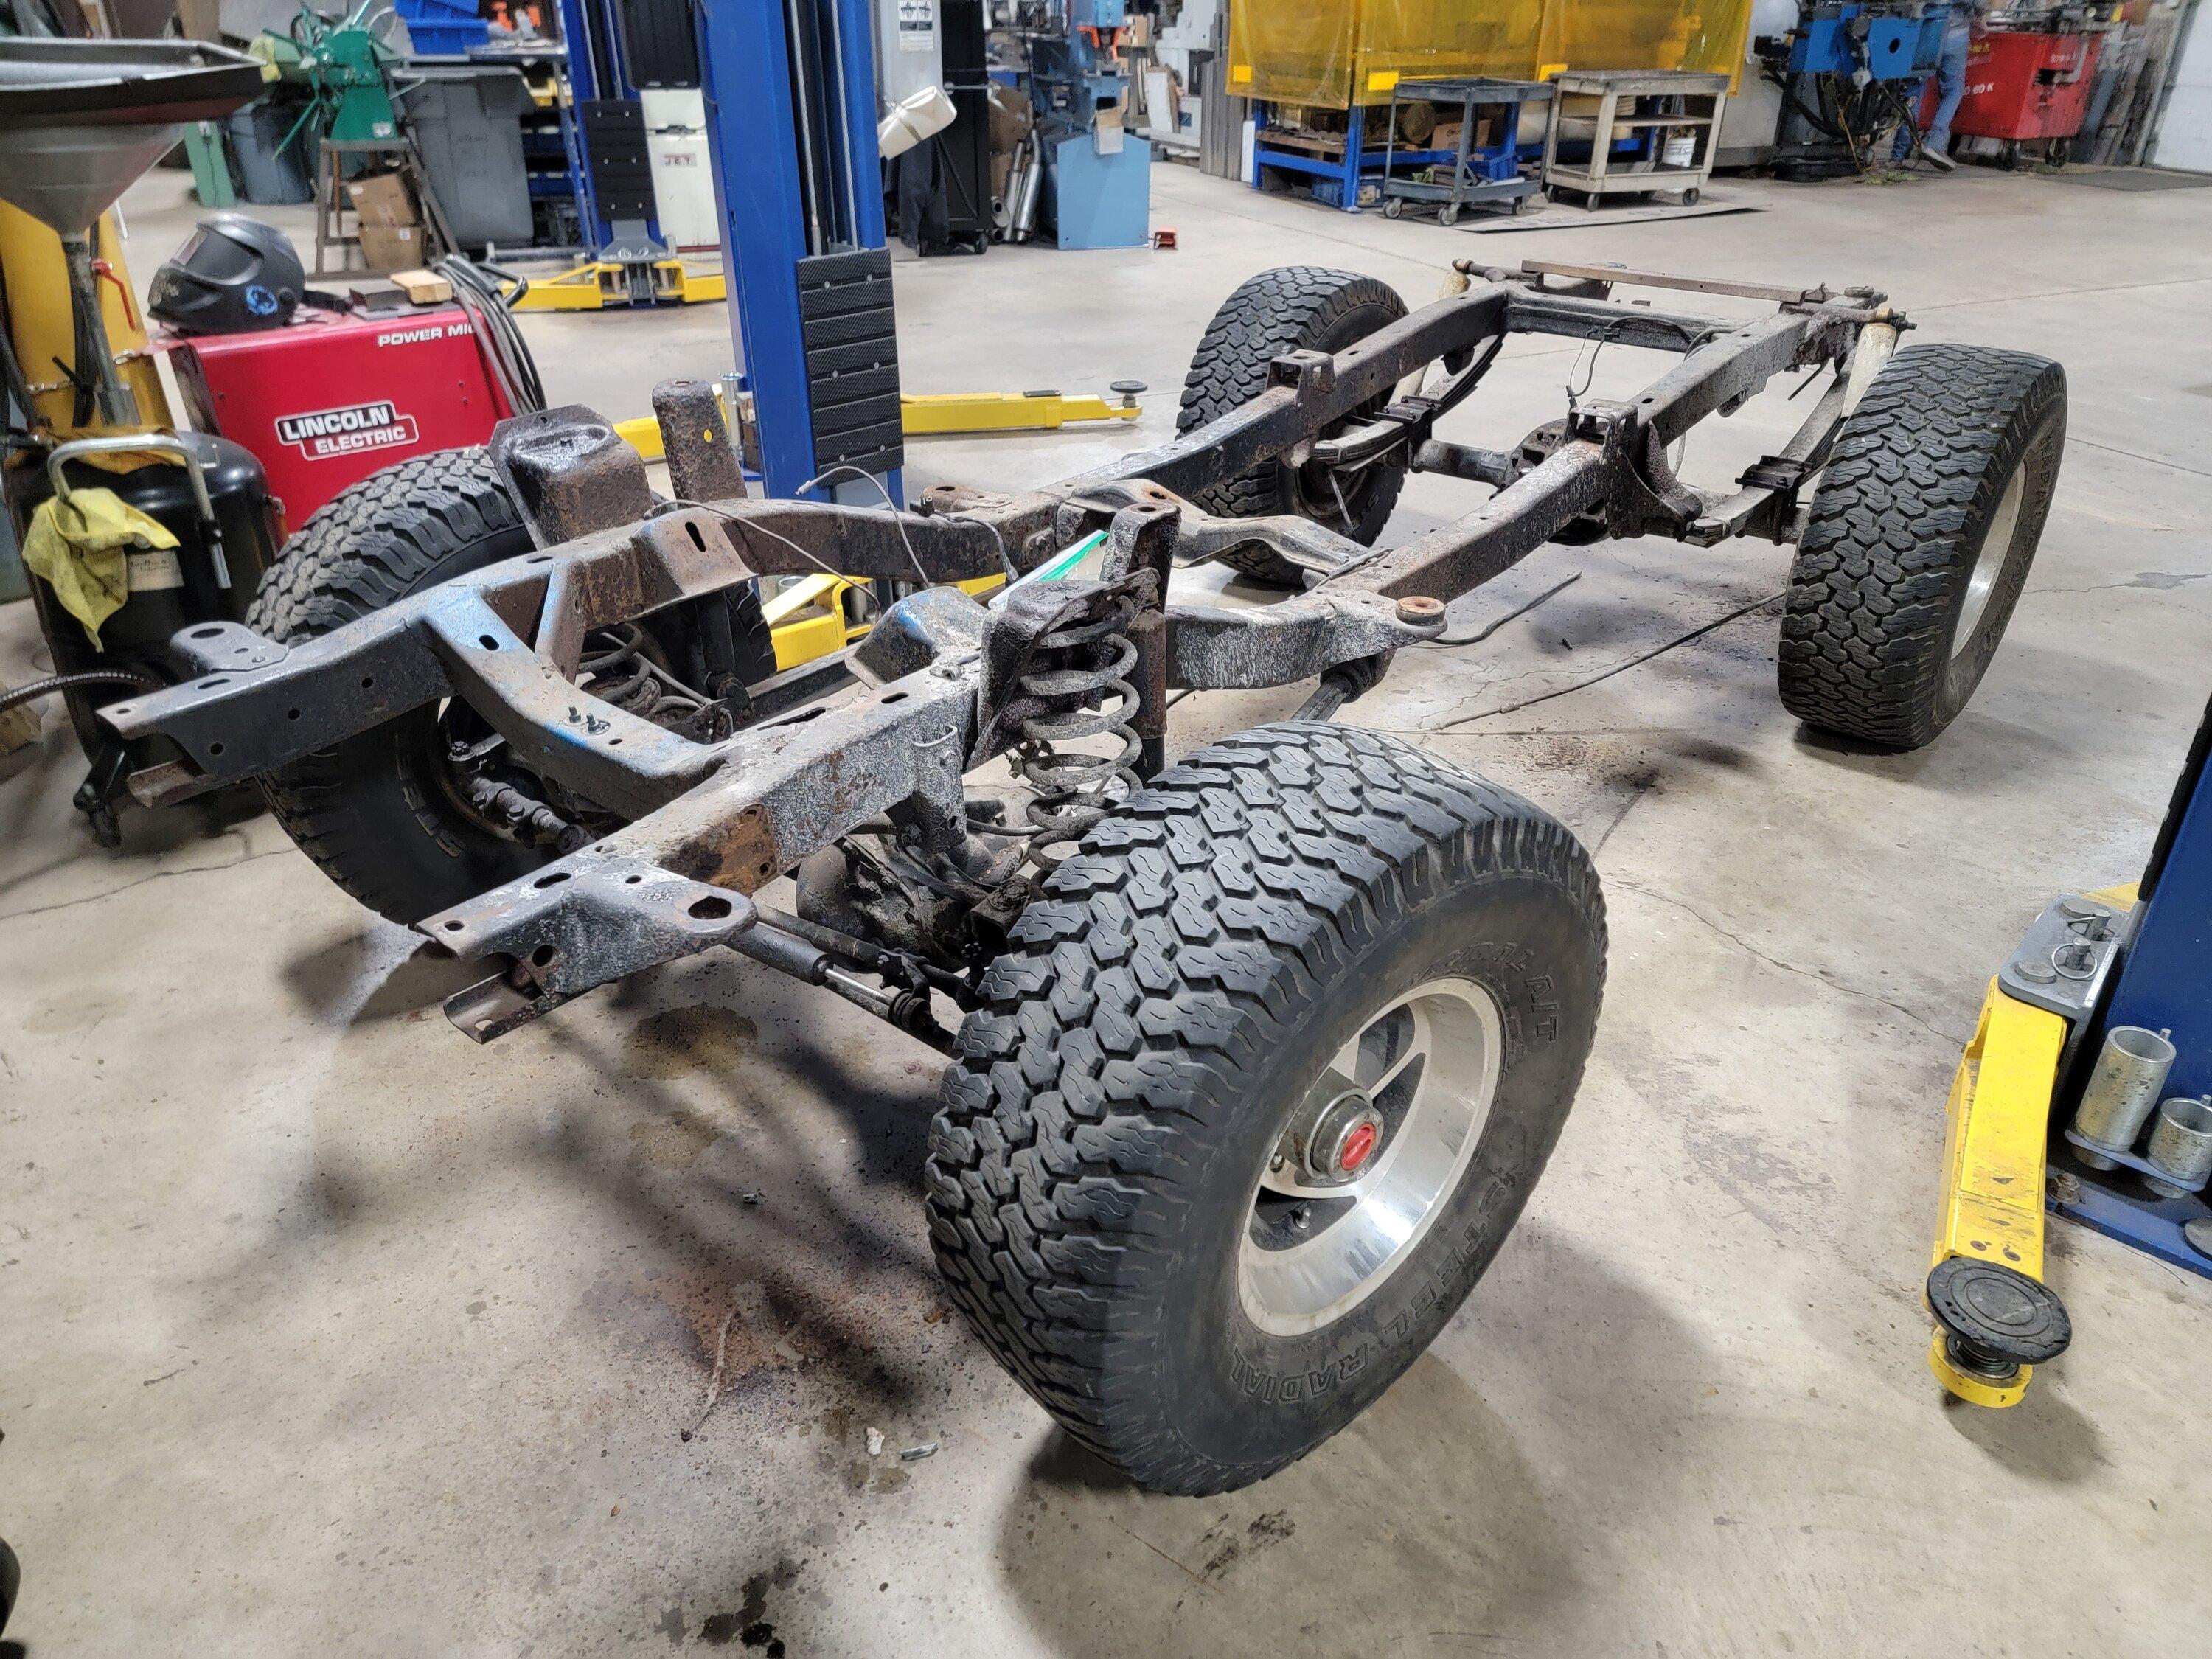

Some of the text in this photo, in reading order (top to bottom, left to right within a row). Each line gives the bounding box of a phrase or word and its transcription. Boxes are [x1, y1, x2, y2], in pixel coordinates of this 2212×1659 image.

[378, 327, 442, 347] POWER
[284, 406, 390, 440] LINCOLN
[315, 425, 406, 455] ELECTRIC
[1229, 1181, 1508, 1405] STEEL RADIAL
